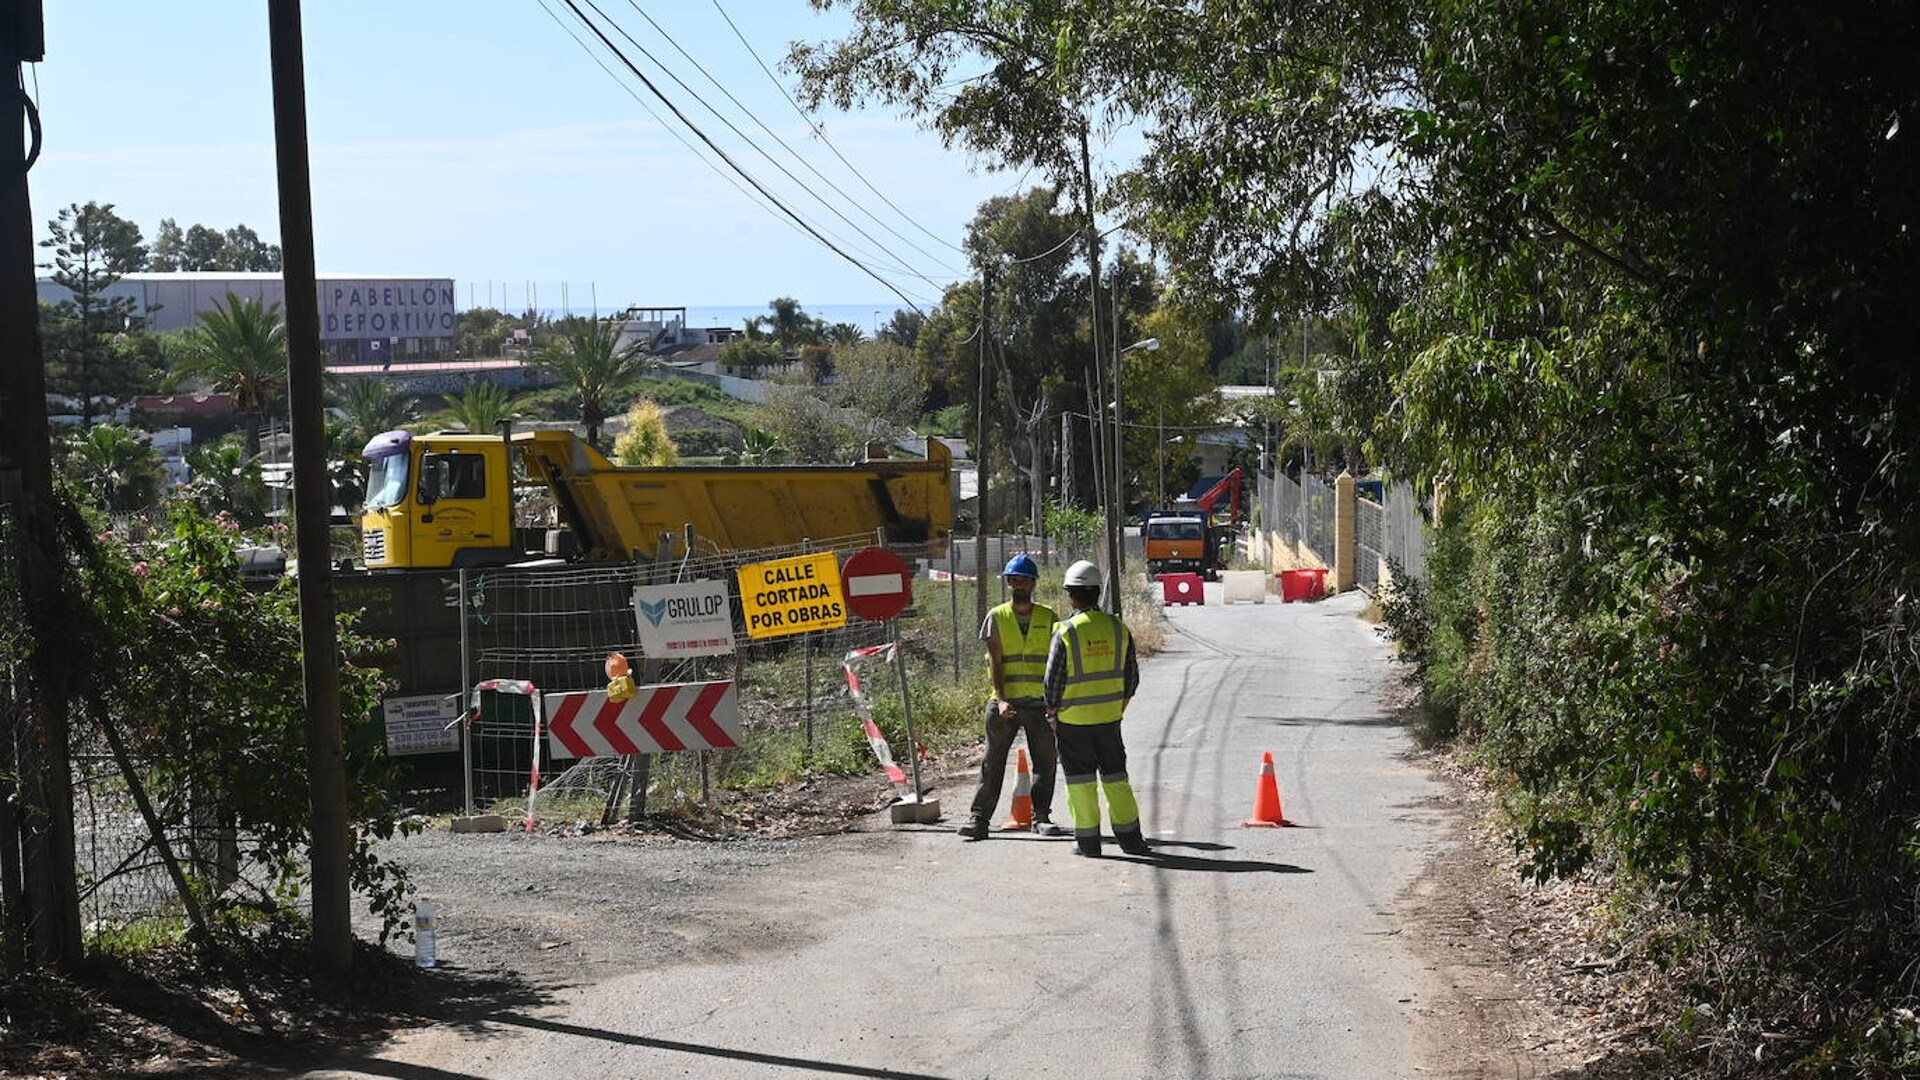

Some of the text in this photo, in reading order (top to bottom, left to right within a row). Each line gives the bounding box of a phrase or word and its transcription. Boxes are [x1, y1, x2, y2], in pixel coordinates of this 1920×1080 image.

[334, 281, 454, 306] PABELLÓN
[327, 312, 454, 332] DEPORTIVO
[764, 563, 815, 585] CALLE
[667, 594, 723, 618] GRULOP
[756, 583, 830, 607] CORTADA
[750, 602, 842, 630] POR OBRAS
